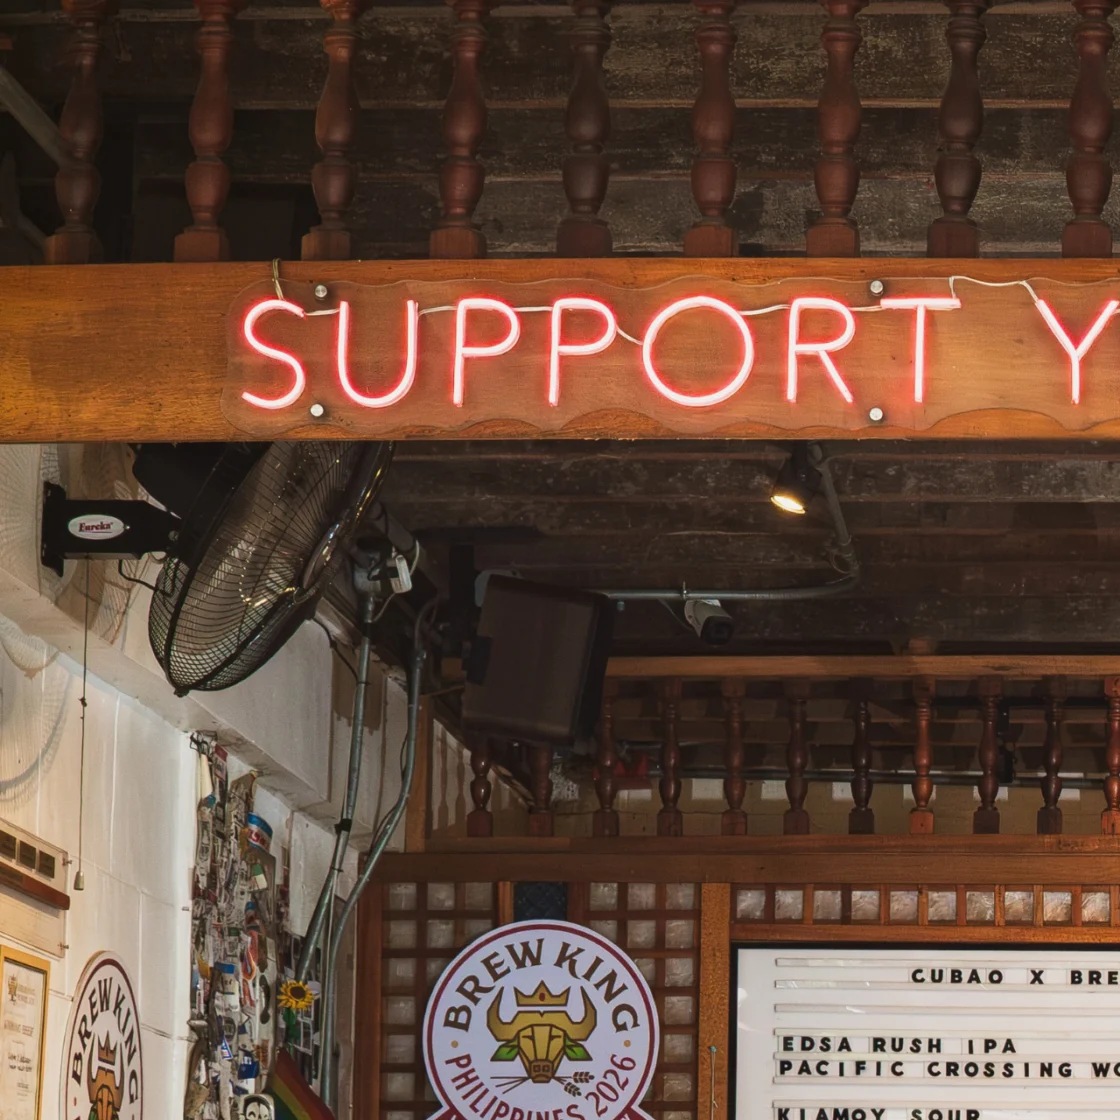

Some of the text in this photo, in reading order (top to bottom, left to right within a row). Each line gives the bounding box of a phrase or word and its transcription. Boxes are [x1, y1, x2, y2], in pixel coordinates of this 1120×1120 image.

[241, 295, 962, 410] SUPPORT
[78, 521, 112, 533] Eureka
[443, 938, 640, 1033] BREW KING
[912, 969, 1004, 985] CUBAO
[1030, 969, 1045, 985] X
[72, 977, 139, 1104] BREW KING
[782, 1036, 1017, 1054] EDSA RUSH IPA
[585, 1054, 637, 1117] 2026
[779, 1060, 905, 1077] PACIFIC
[928, 1061, 1072, 1078] CROSSING
